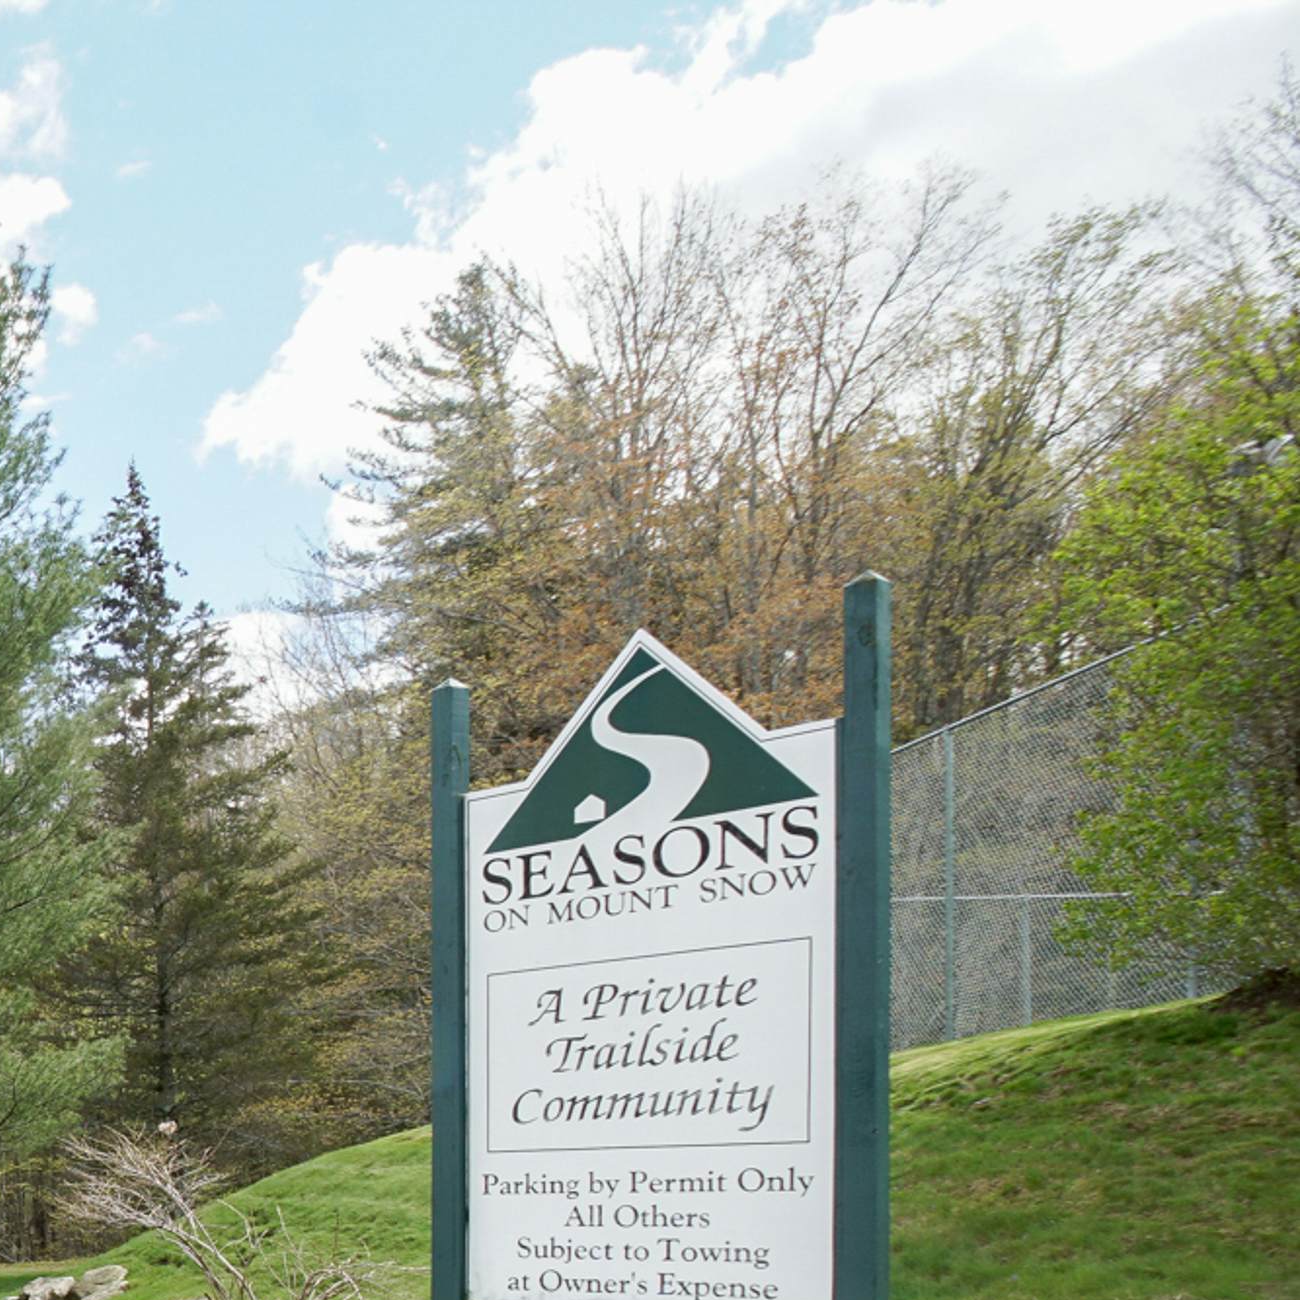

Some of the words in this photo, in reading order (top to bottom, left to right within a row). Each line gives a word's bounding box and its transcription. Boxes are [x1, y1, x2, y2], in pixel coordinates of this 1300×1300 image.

[482, 805, 819, 905] SEASONS
[483, 905, 530, 933] ON
[547, 884, 679, 925] MOUNT
[700, 863, 818, 903] SNOW
[528, 988, 566, 1027] A
[582, 974, 758, 1020] Private
[545, 1018, 740, 1073] Trailside
[511, 1078, 775, 1132] Community
[482, 1173, 580, 1199] Parking
[589, 1172, 621, 1199] by
[629, 1170, 727, 1194] Permit
[738, 1167, 815, 1198] Only
[564, 1206, 603, 1228] All
[614, 1205, 711, 1229] Others
[517, 1238, 614, 1265] Subject
[624, 1244, 649, 1262] to
[657, 1238, 770, 1269] Towing
[507, 1275, 531, 1292] at
[539, 1271, 648, 1296] Owner's
